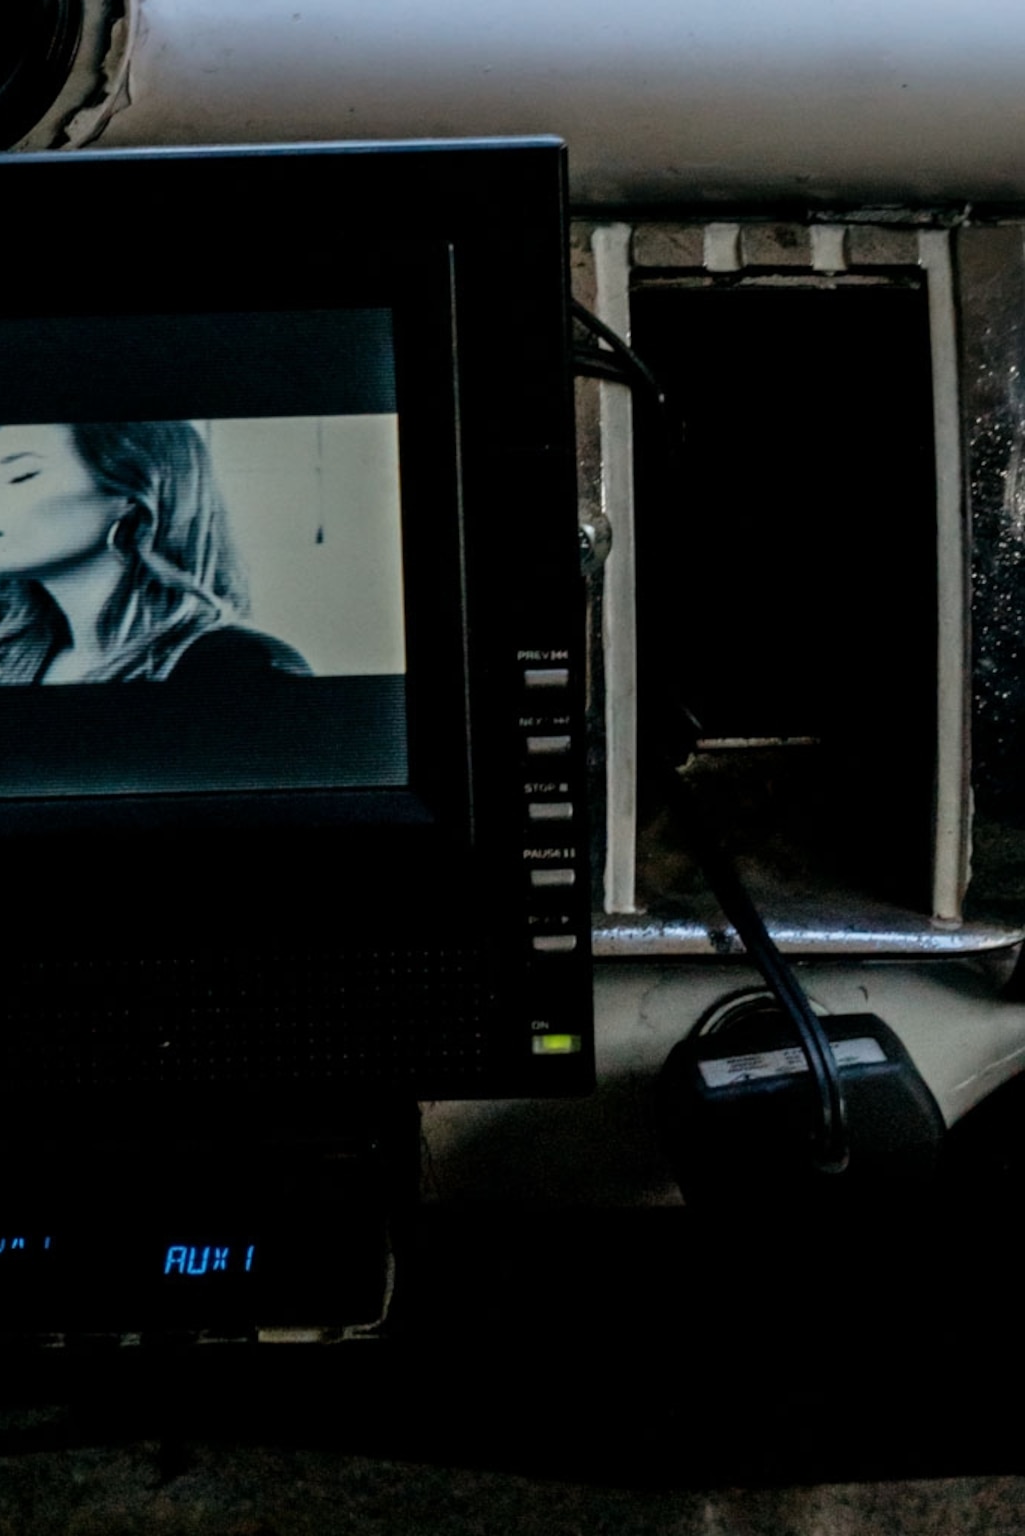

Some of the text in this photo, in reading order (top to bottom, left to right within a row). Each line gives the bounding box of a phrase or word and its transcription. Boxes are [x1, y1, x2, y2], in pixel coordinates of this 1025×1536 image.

[523, 783, 556, 794] STOP
[164, 1244, 256, 1276] AUX 1
